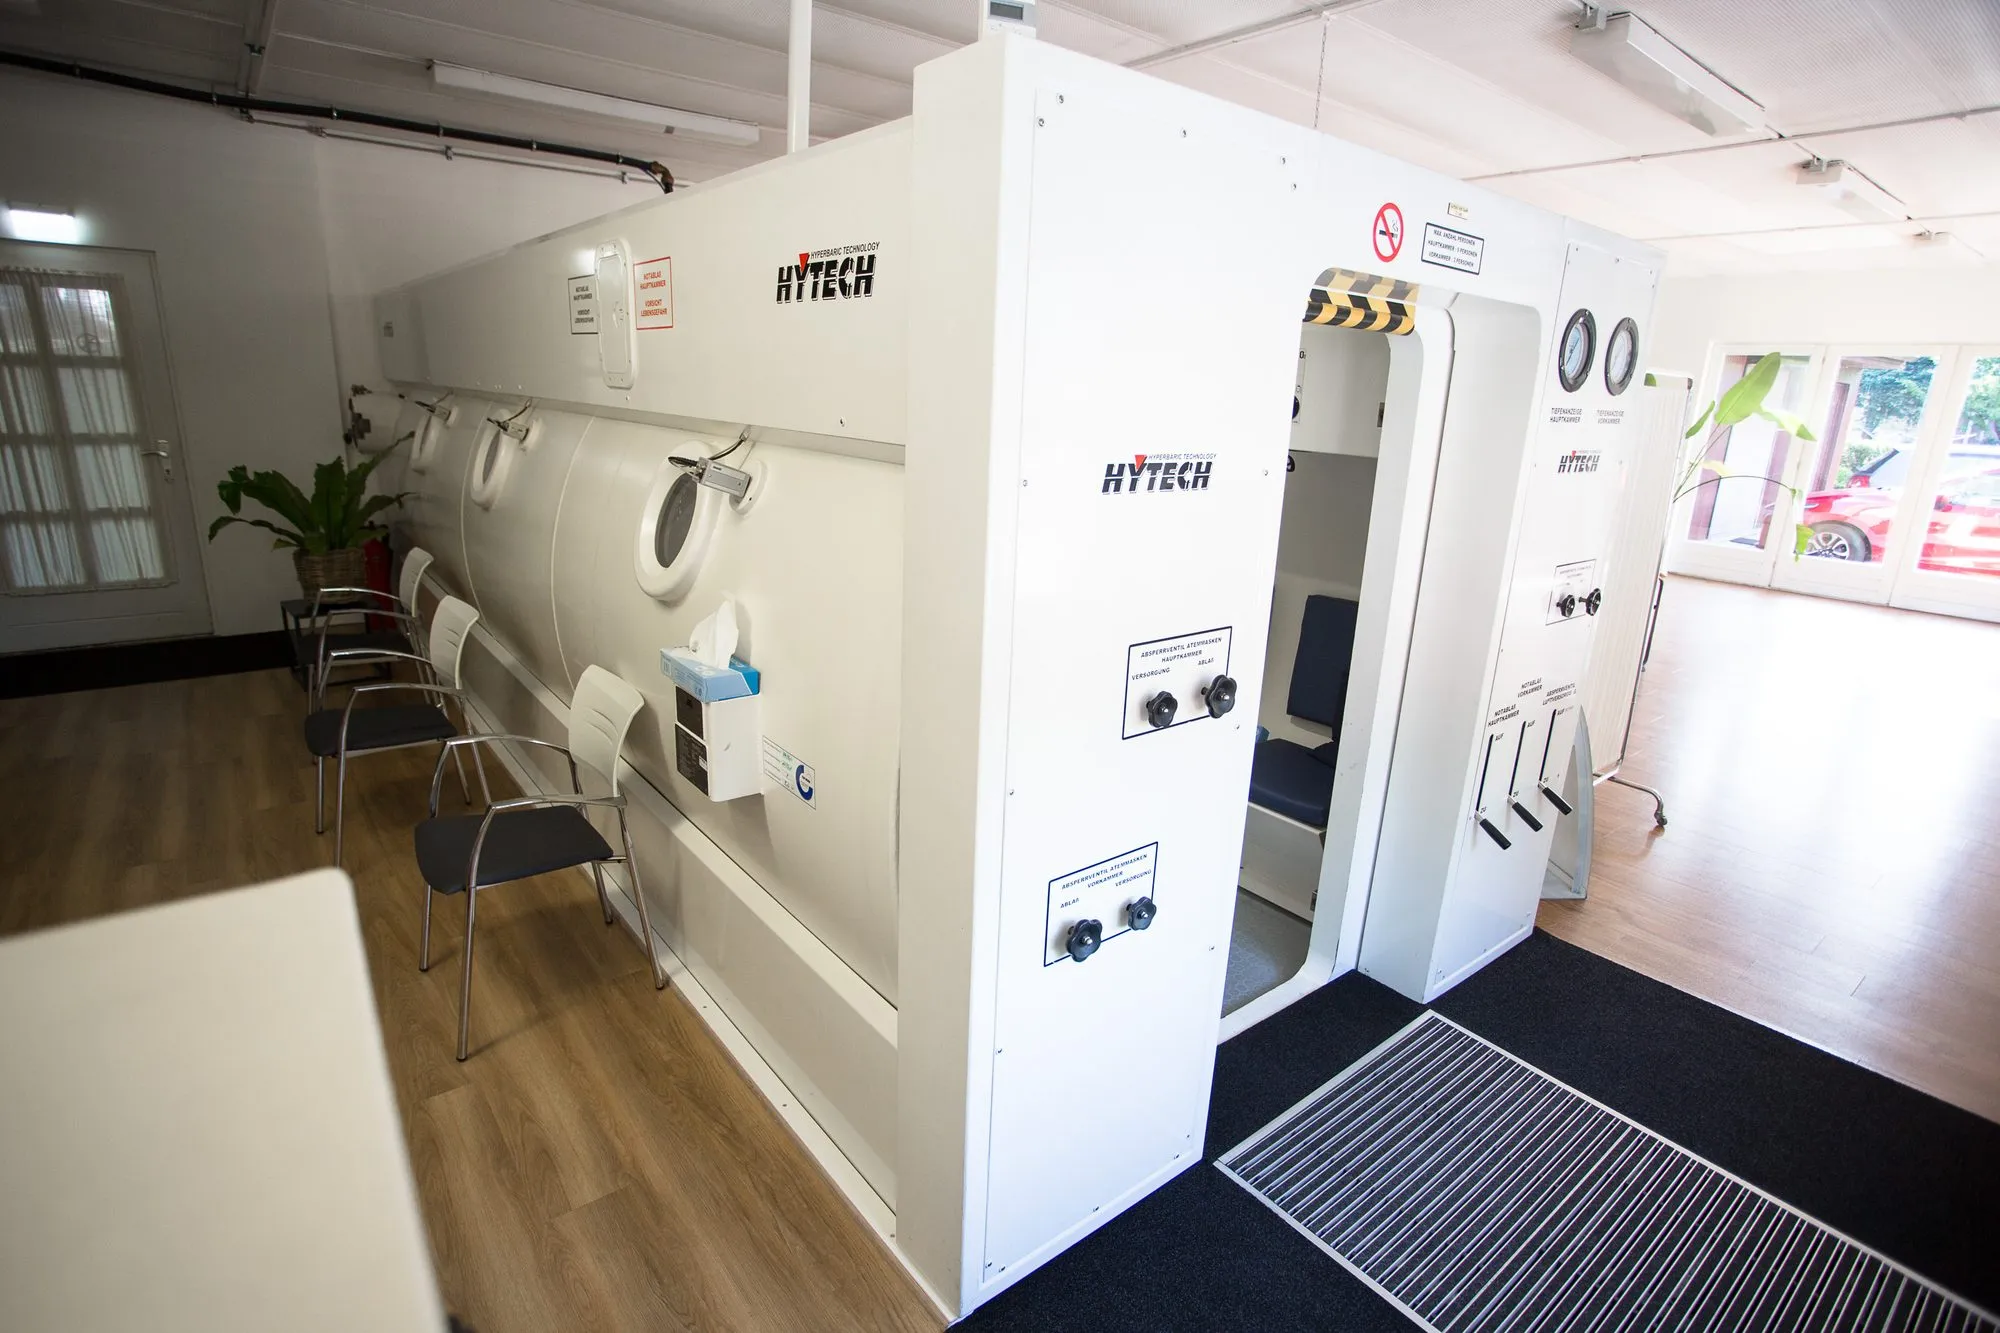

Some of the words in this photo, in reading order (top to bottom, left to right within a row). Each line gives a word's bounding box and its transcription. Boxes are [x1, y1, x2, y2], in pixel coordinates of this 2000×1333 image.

[811, 247, 842, 259] HYPERBARIC
[843, 241, 880, 255] TECHNOLOGY
[776, 253, 876, 304] HYTECH
[1148, 453, 1182, 461] HYPERBARIC
[1183, 452, 1217, 460] TECHNOLOGY
[1558, 451, 1600, 473] HYTECH
[1102, 455, 1213, 495] HYTECH
[1140, 645, 1185, 658] ABSPERRVENTIL
[1186, 637, 1222, 650] ATEMMASKEN
[1161, 649, 1203, 663] HAUPTKAMMER
[1131, 667, 1171, 681] VERSORGUNG
[1527, 719, 1536, 728] AUF
[1495, 732, 1504, 741] AUF
[1061, 869, 1109, 890] ABSPERRVENTIL
[1109, 853, 1148, 872] ATEMMASKEN
[1087, 870, 1124, 888] VORKAMMER
[1114, 869, 1152, 887] VERSORGUNG
